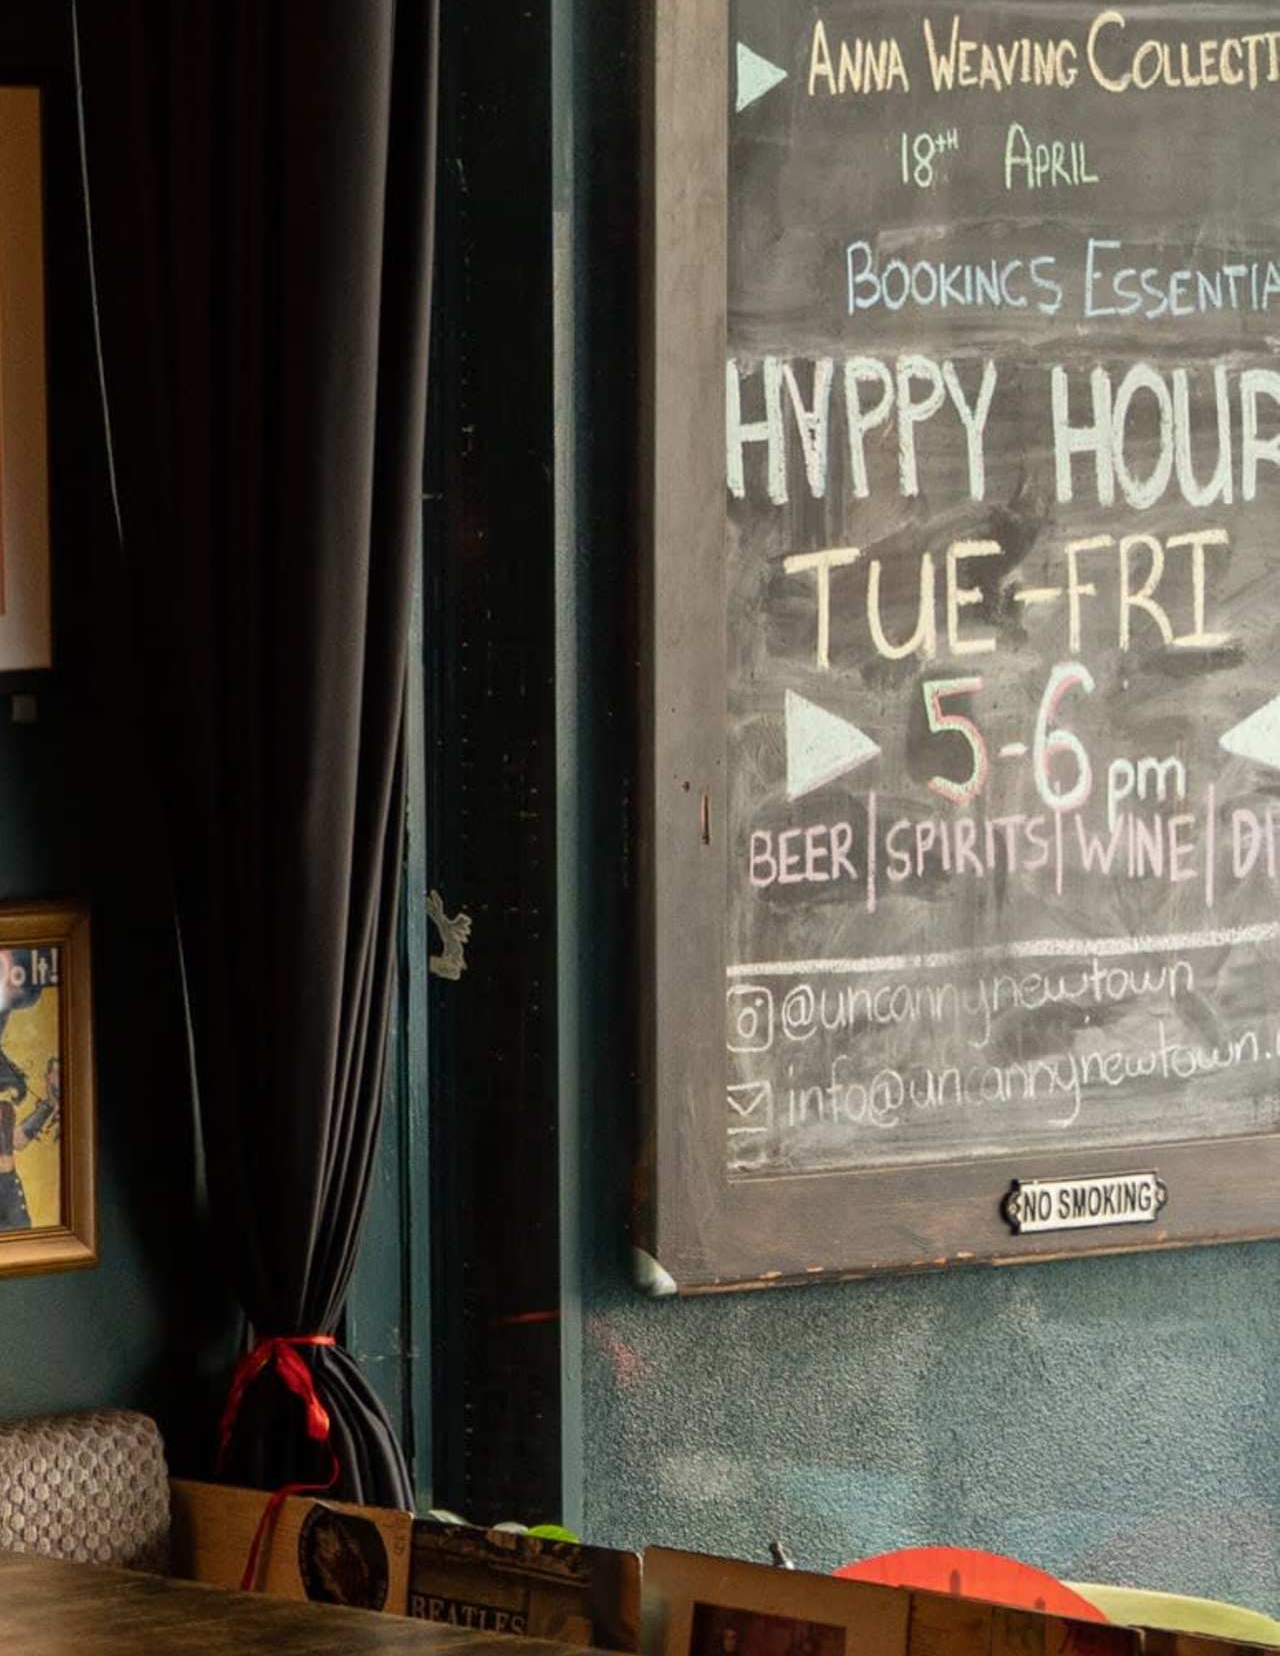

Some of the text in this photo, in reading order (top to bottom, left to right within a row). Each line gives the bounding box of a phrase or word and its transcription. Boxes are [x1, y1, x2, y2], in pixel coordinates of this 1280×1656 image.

[808, 18, 910, 96] ANNA
[924, 14, 1078, 92] WEAVING
[1005, 122, 1100, 190] APRIL
[749, 821, 858, 887] BEER
[886, 813, 1049, 882] SPIRITS
[1075, 812, 1209, 882] WINE
[787, 1020, 1280, 1130] info@uncannynewtown.
[1023, 1180, 1153, 1223] NO SMOKING
[410, 1593, 527, 1636] BEATLES
